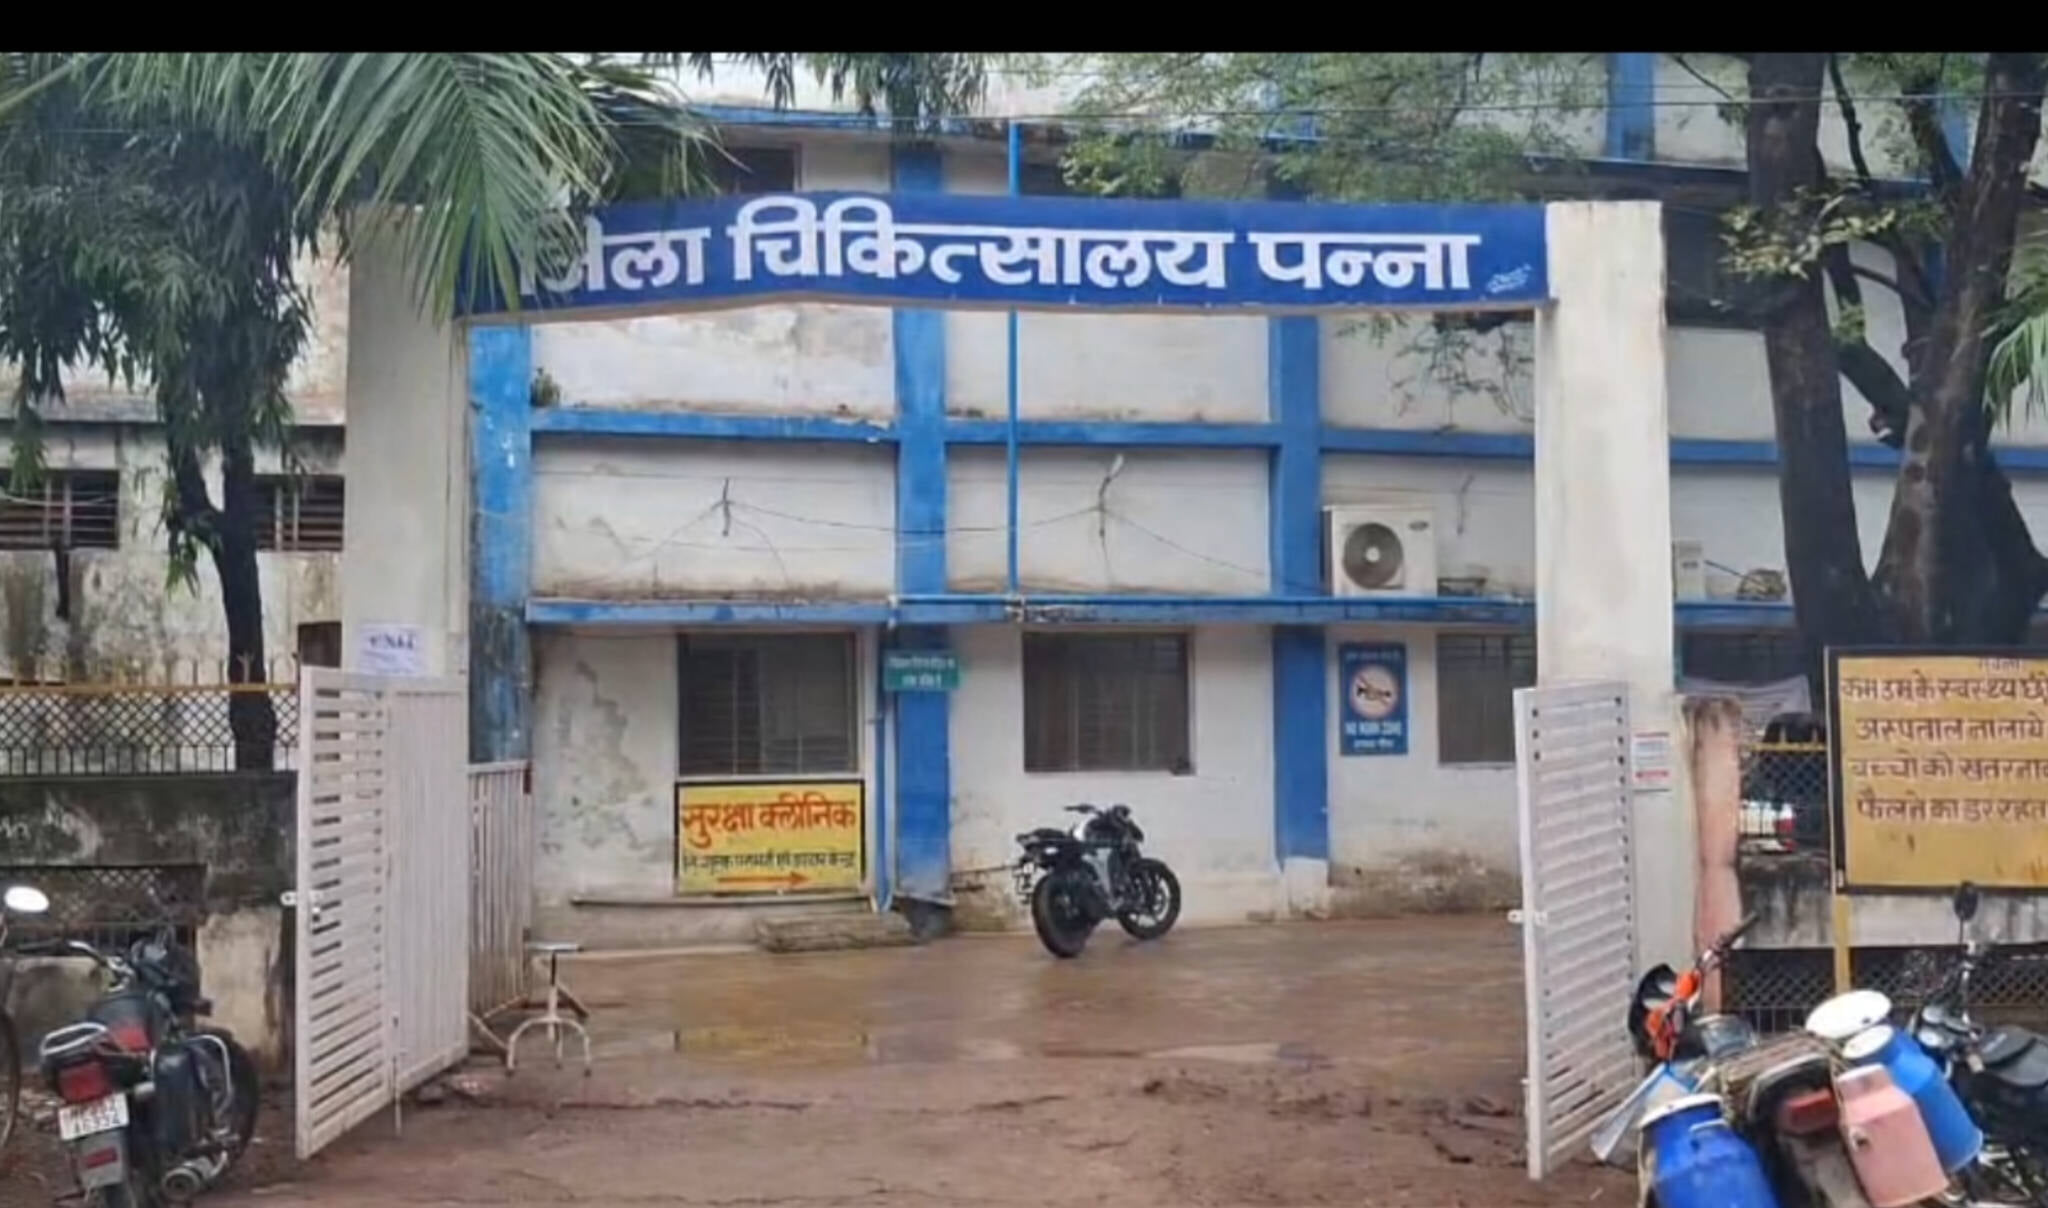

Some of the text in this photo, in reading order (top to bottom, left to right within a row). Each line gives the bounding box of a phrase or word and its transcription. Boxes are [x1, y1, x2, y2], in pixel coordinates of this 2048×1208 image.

[726, 196, 1234, 290] चिकित्सालय
[1247, 234, 1481, 291] पन्ना
[1856, 717, 1963, 741] अस्पताल
[681, 791, 859, 850] सुरक्षा क्लीनिक
